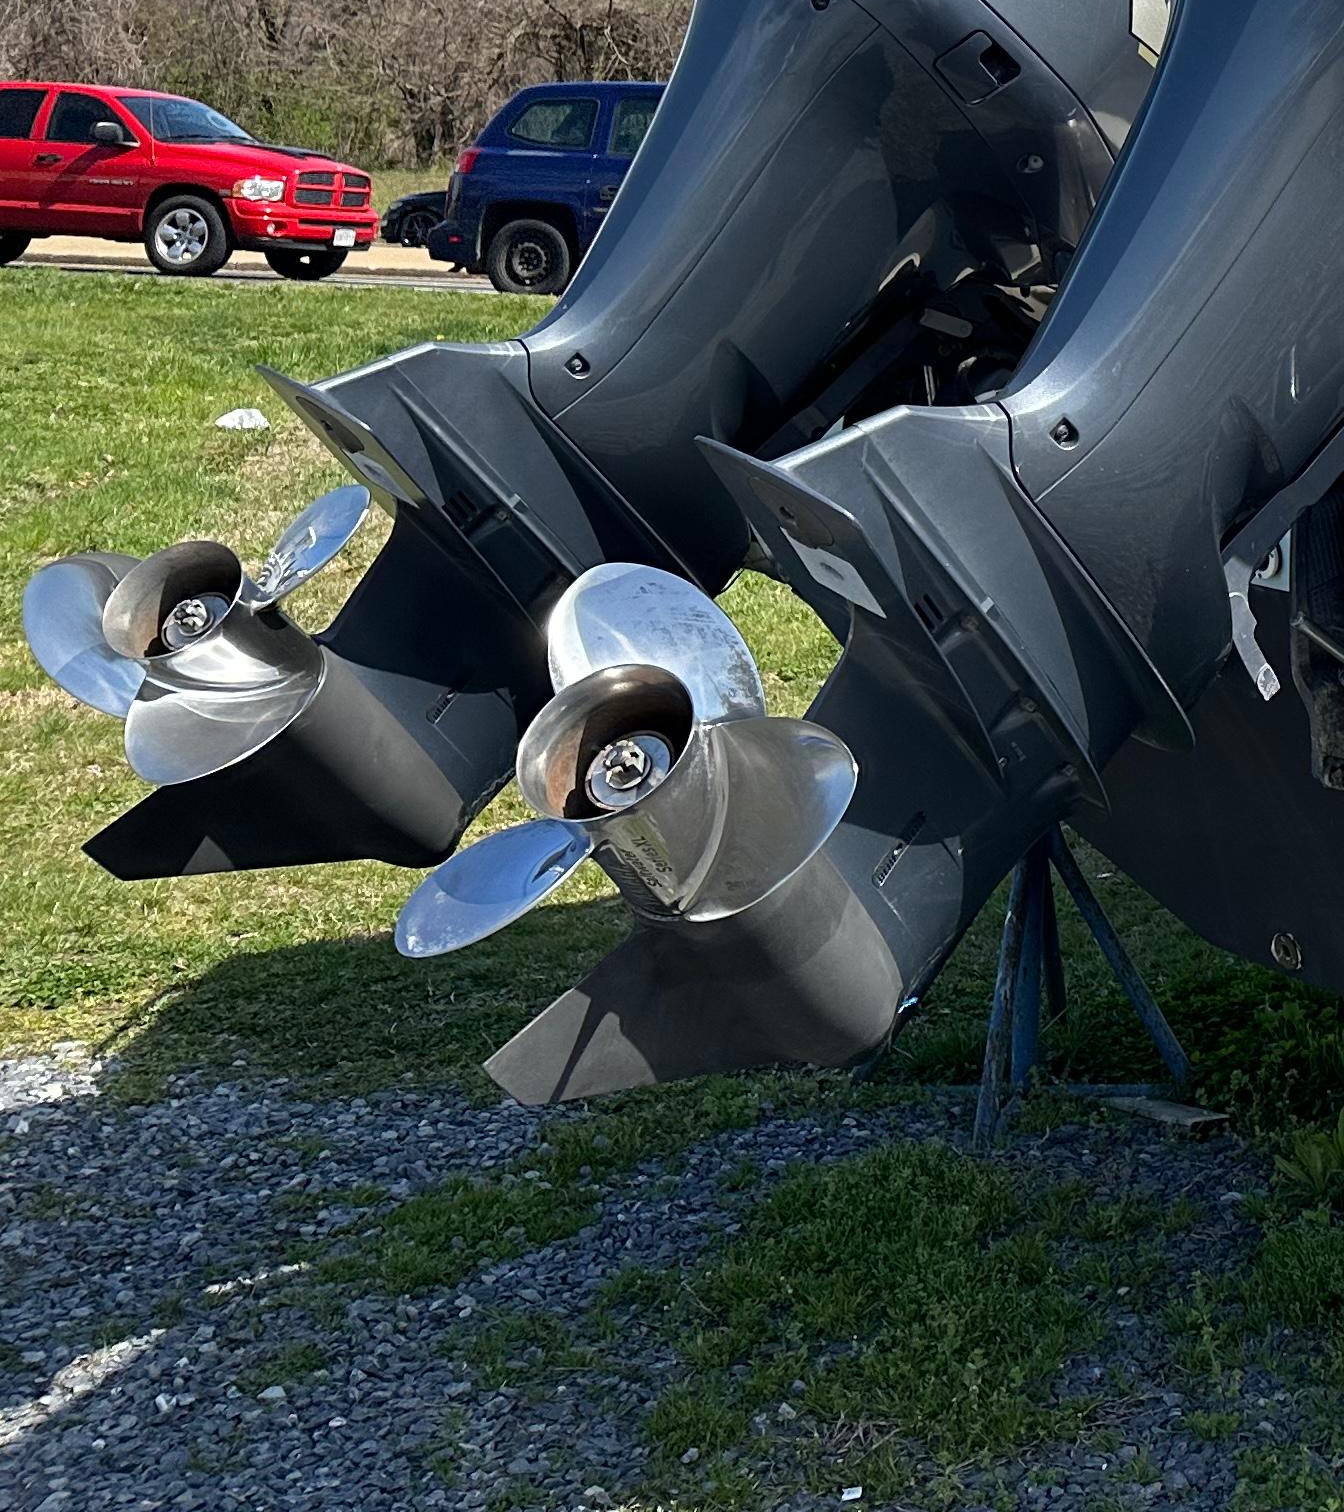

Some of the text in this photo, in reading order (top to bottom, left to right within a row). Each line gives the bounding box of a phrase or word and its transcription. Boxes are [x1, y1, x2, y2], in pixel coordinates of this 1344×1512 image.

[620, 849, 663, 888] Saltwater
[631, 835, 673, 873] Series XL
